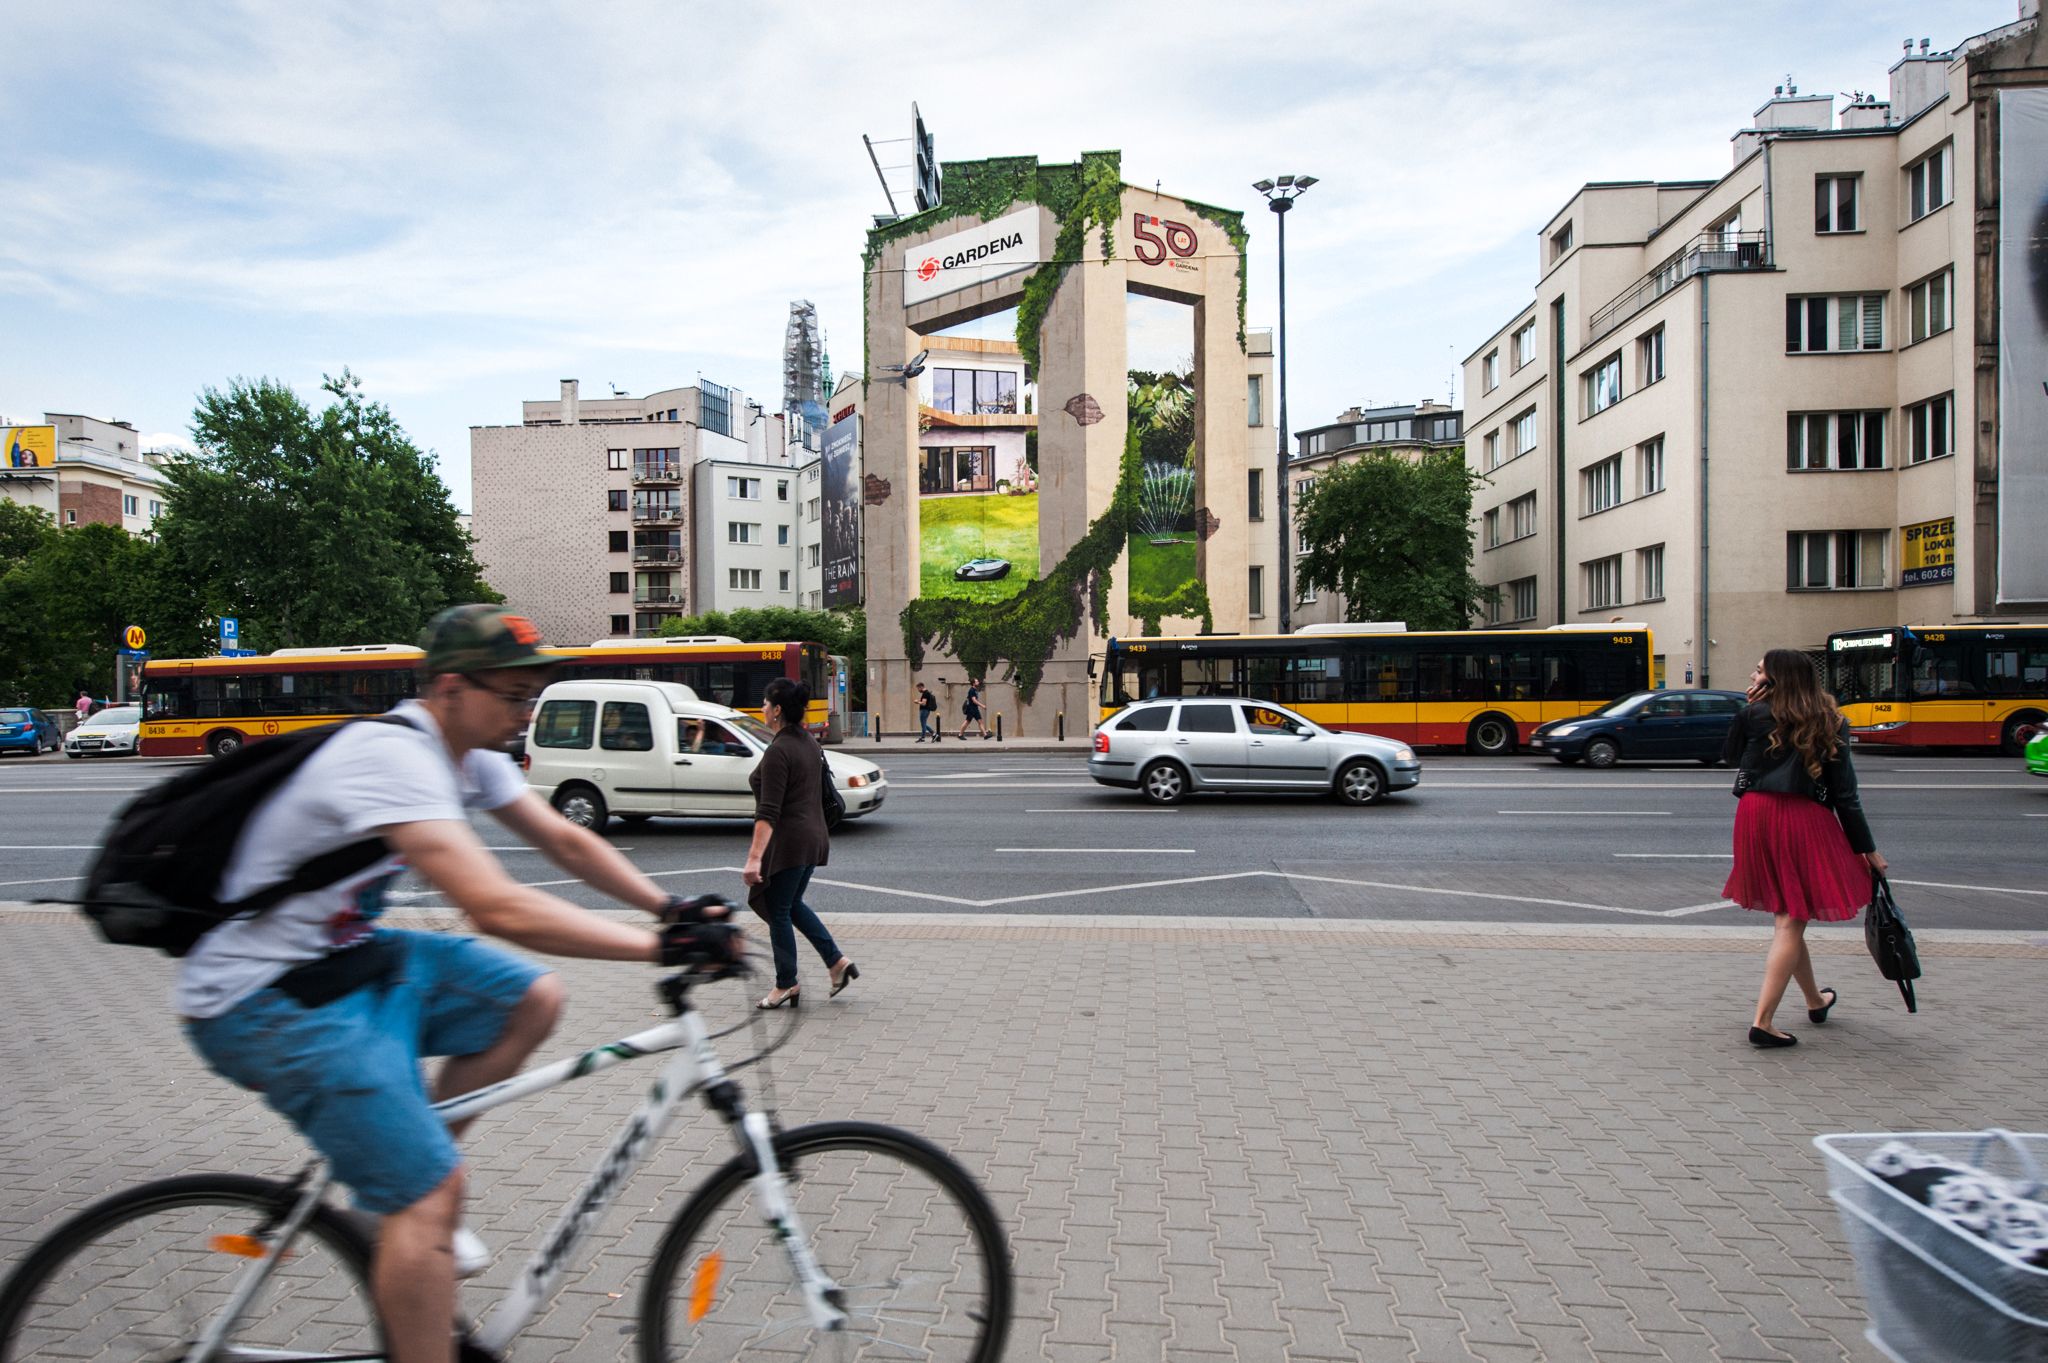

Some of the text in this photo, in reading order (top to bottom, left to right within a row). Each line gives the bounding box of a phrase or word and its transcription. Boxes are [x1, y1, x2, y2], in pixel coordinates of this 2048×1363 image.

[1134, 213, 1198, 265] 50
[943, 233, 1023, 269] GARDENA
[1925, 554, 1941, 564] 101
[825, 561, 856, 581] THE RAIN
[1904, 567, 1954, 582] tel. 602 66
[224, 620, 235, 637] P
[130, 629, 145, 645] M
[1612, 636, 1633, 644] 9433
[761, 651, 782, 660] 8438
